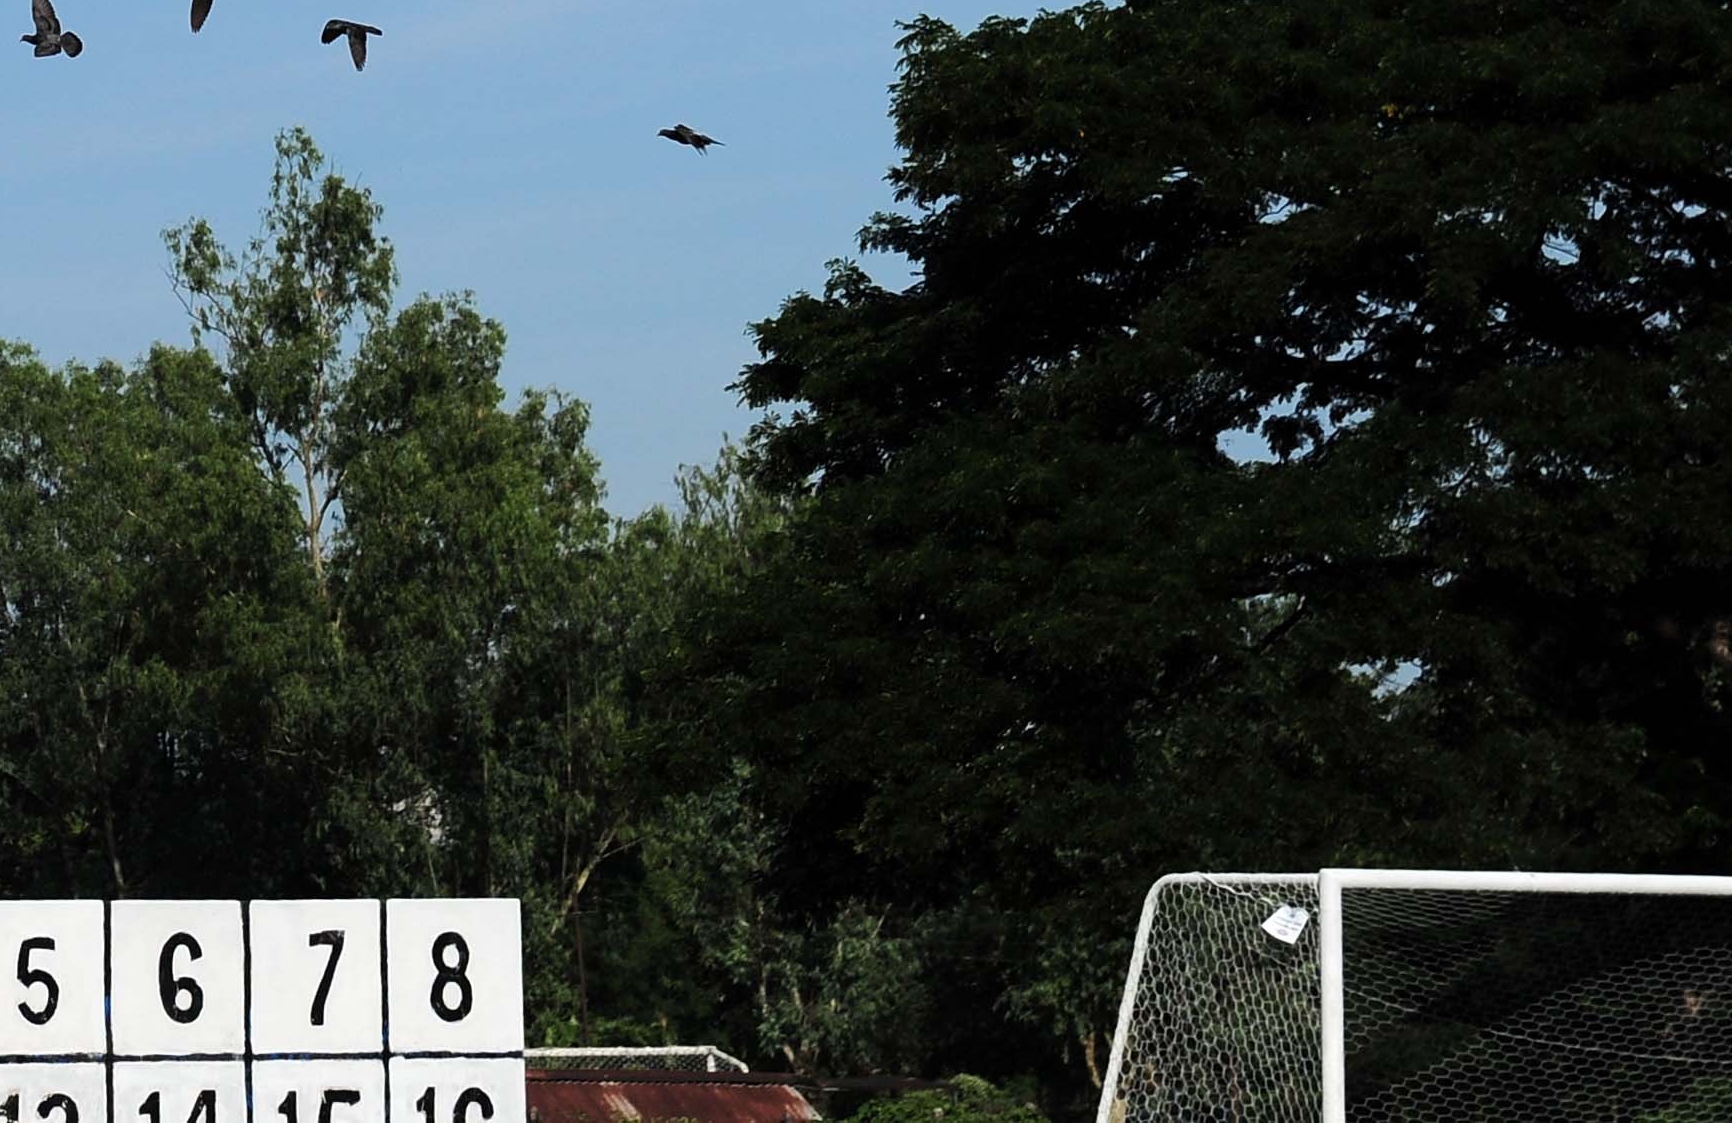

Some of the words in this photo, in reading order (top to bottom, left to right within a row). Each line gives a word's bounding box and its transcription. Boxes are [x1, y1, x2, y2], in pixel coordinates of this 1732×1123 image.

[16, 936, 60, 1026] 5
[158, 931, 204, 1024] 6
[308, 930, 346, 1026] 7
[429, 931, 473, 1023] 8
